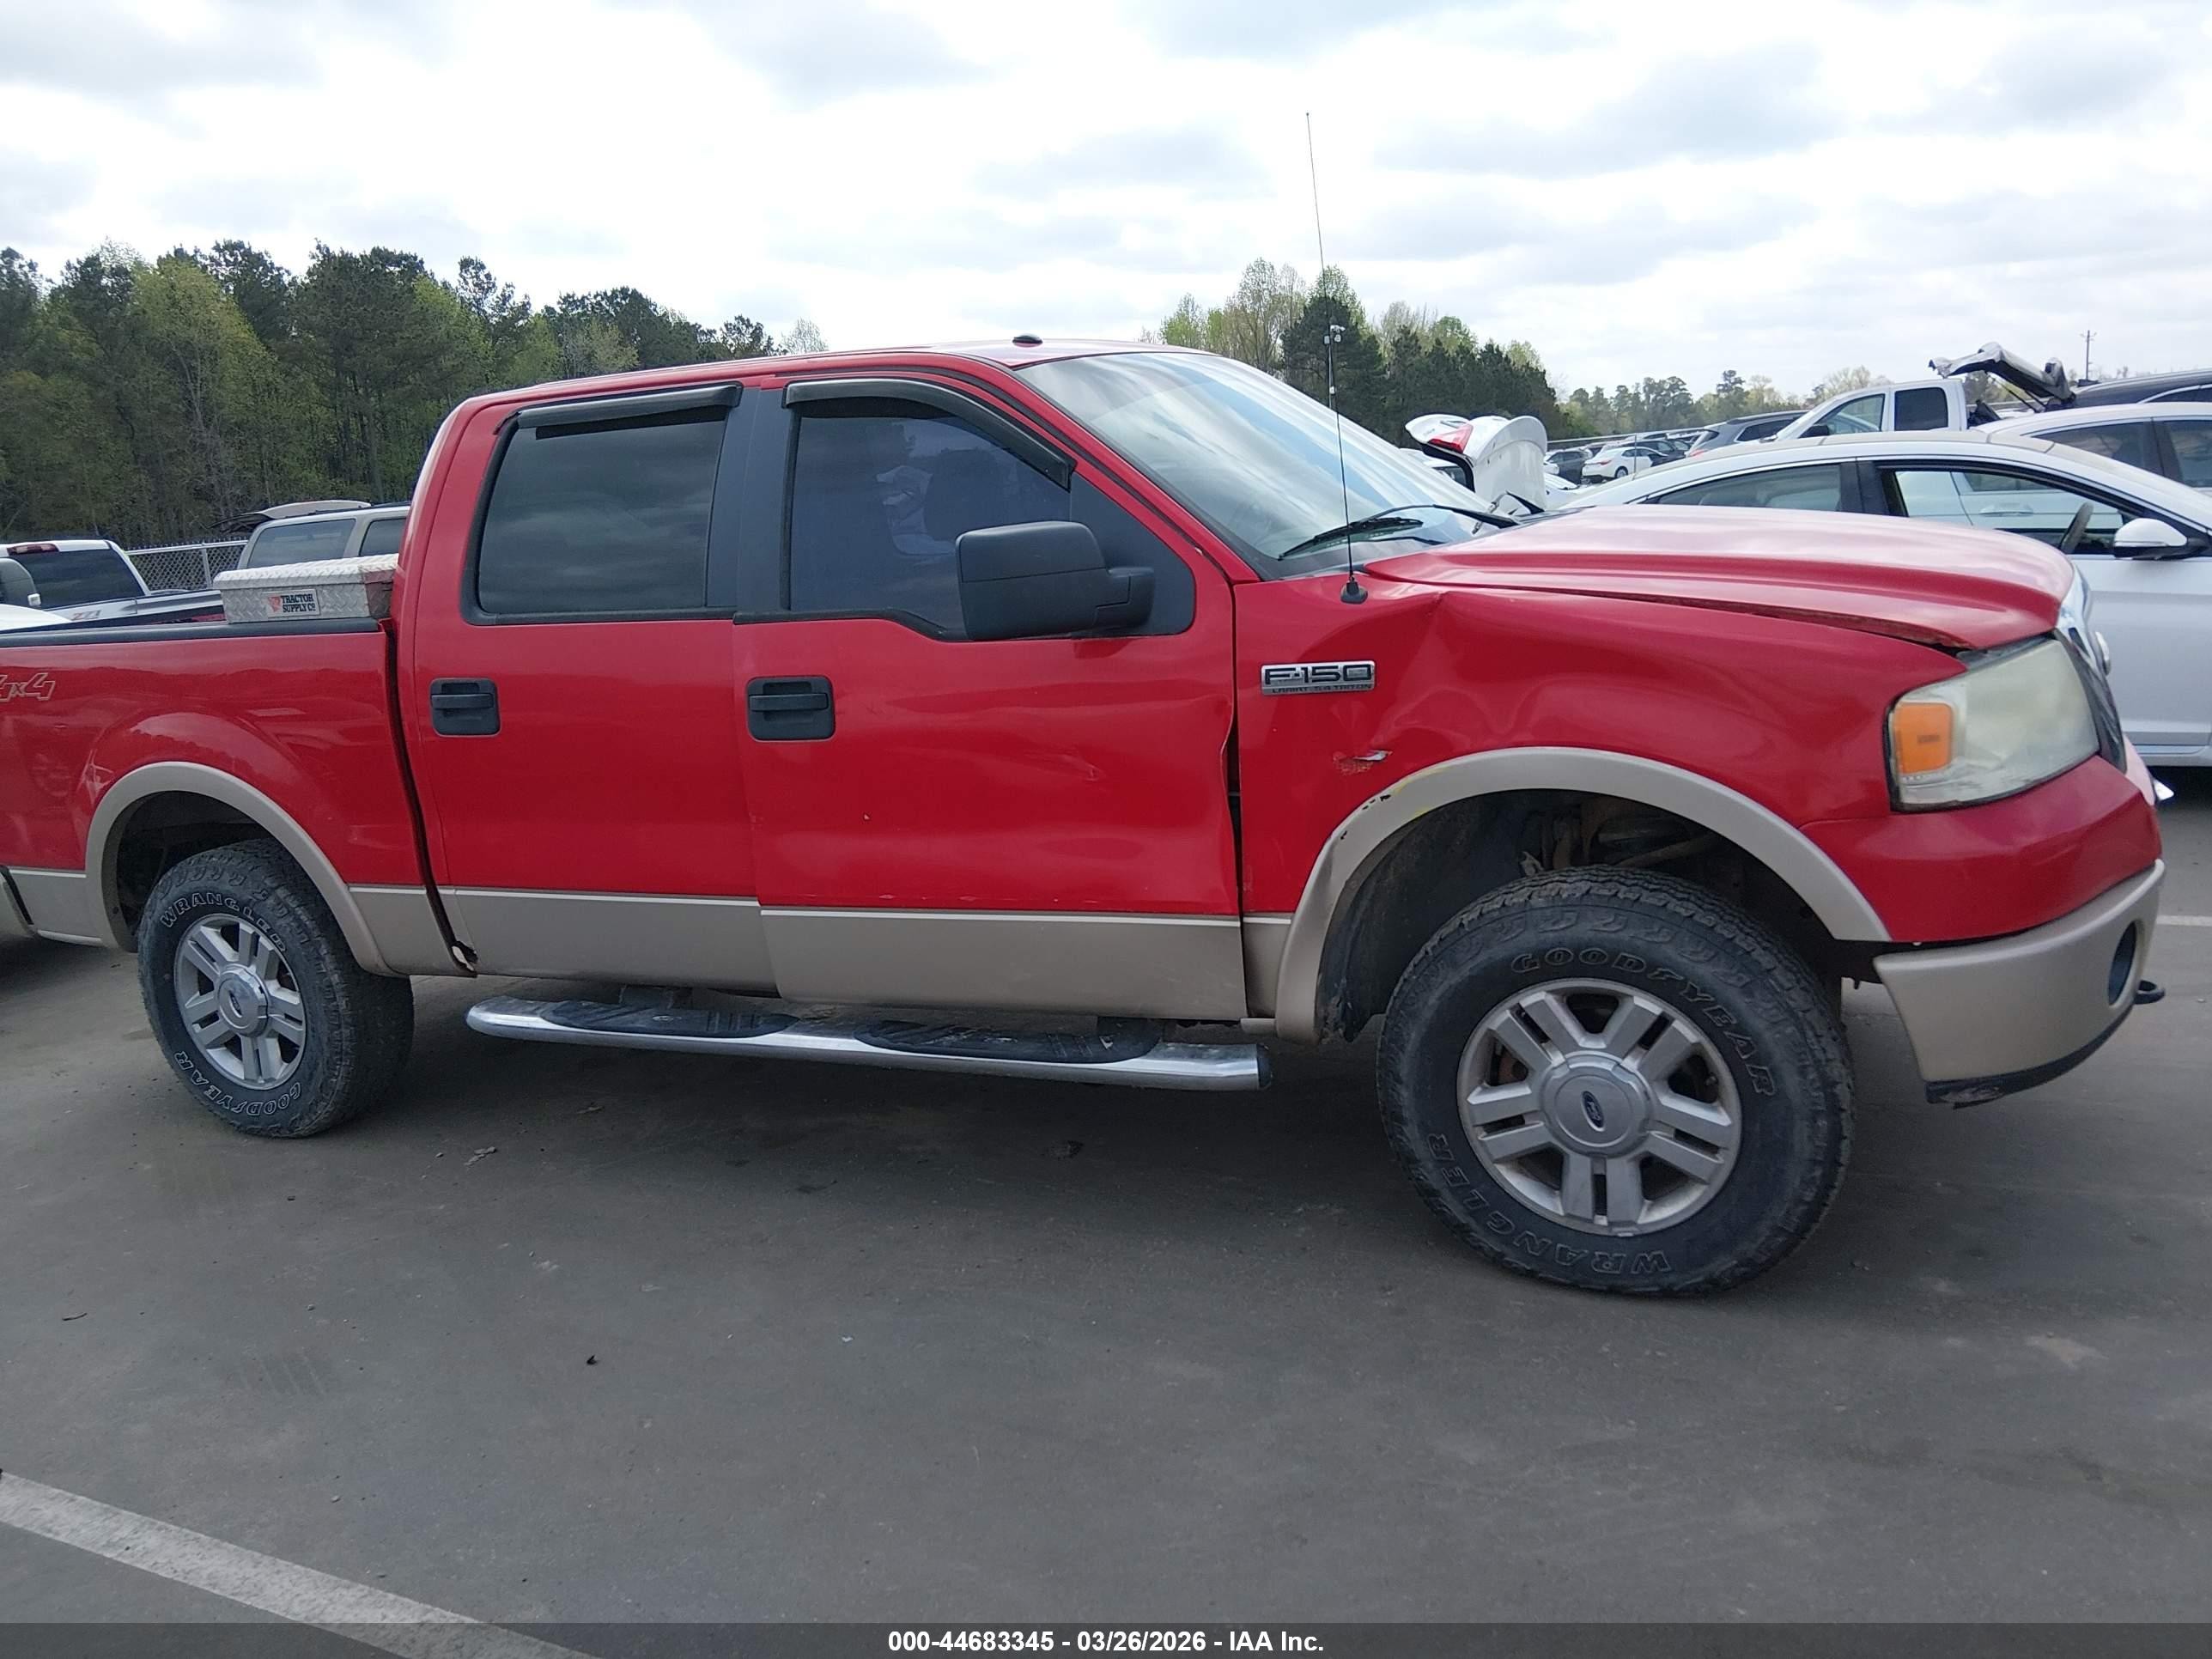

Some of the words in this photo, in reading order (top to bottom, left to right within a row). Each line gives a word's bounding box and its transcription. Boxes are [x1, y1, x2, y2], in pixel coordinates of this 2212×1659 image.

[280, 593, 314, 604] TRACTOR
[283, 604, 307, 612] SUPPLY
[1265, 664, 1372, 685] F-150
[160, 891, 288, 953] WRANGLER
[1510, 947, 1778, 1097] GOODYEAR
[173, 1050, 303, 1116] GOODYEAR
[1426, 1133, 1674, 1275] WRANGLER
